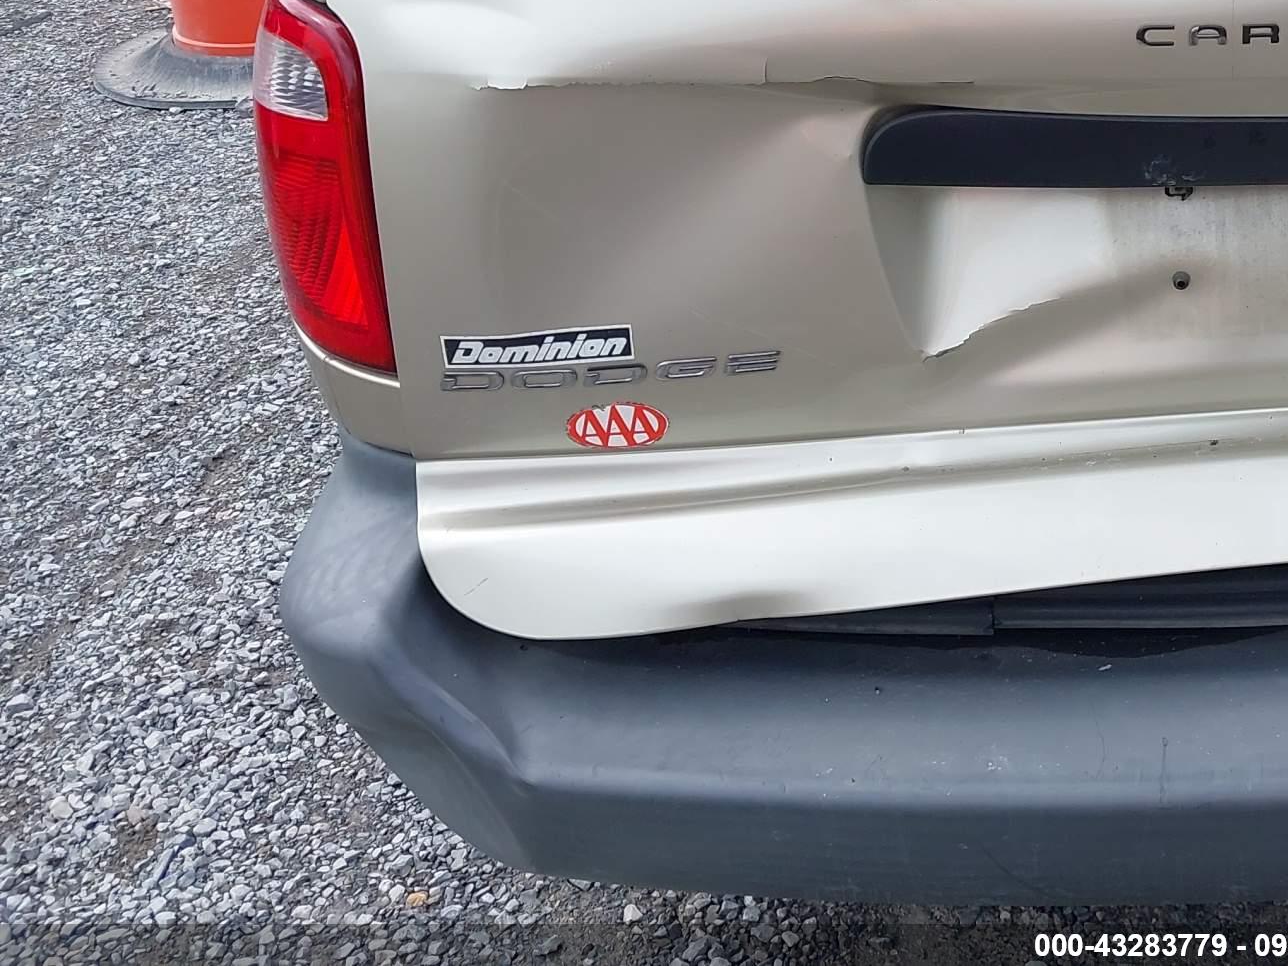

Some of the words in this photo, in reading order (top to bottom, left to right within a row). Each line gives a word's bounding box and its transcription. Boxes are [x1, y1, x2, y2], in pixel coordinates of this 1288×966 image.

[451, 333, 627, 364] Dominion
[440, 350, 781, 392] DODGE
[575, 404, 661, 447] AAA
